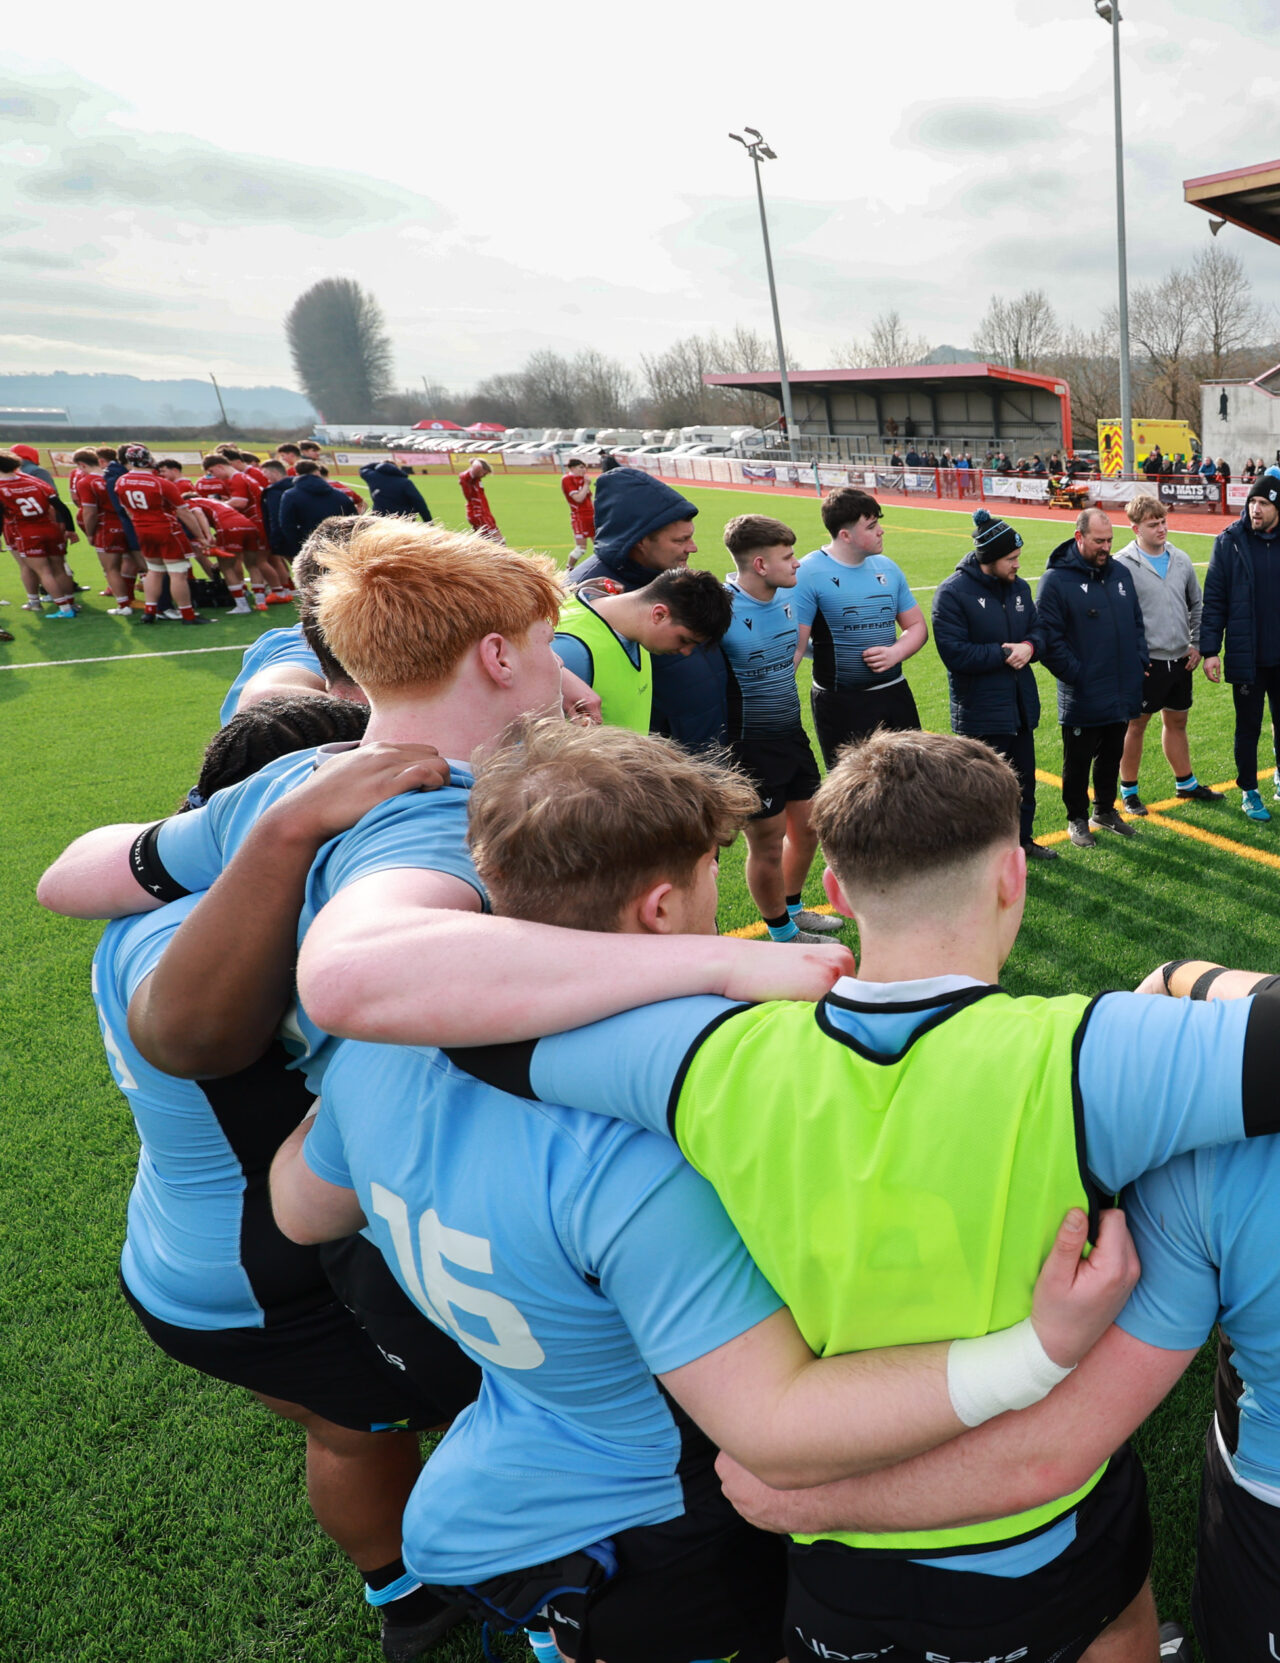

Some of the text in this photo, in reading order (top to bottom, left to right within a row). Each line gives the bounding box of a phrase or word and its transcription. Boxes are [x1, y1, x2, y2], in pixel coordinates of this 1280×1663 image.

[125, 490, 149, 510] 19
[1161, 485, 1204, 495] GJ MATS
[15, 497, 44, 517] 21
[370, 1181, 546, 1370] 16
